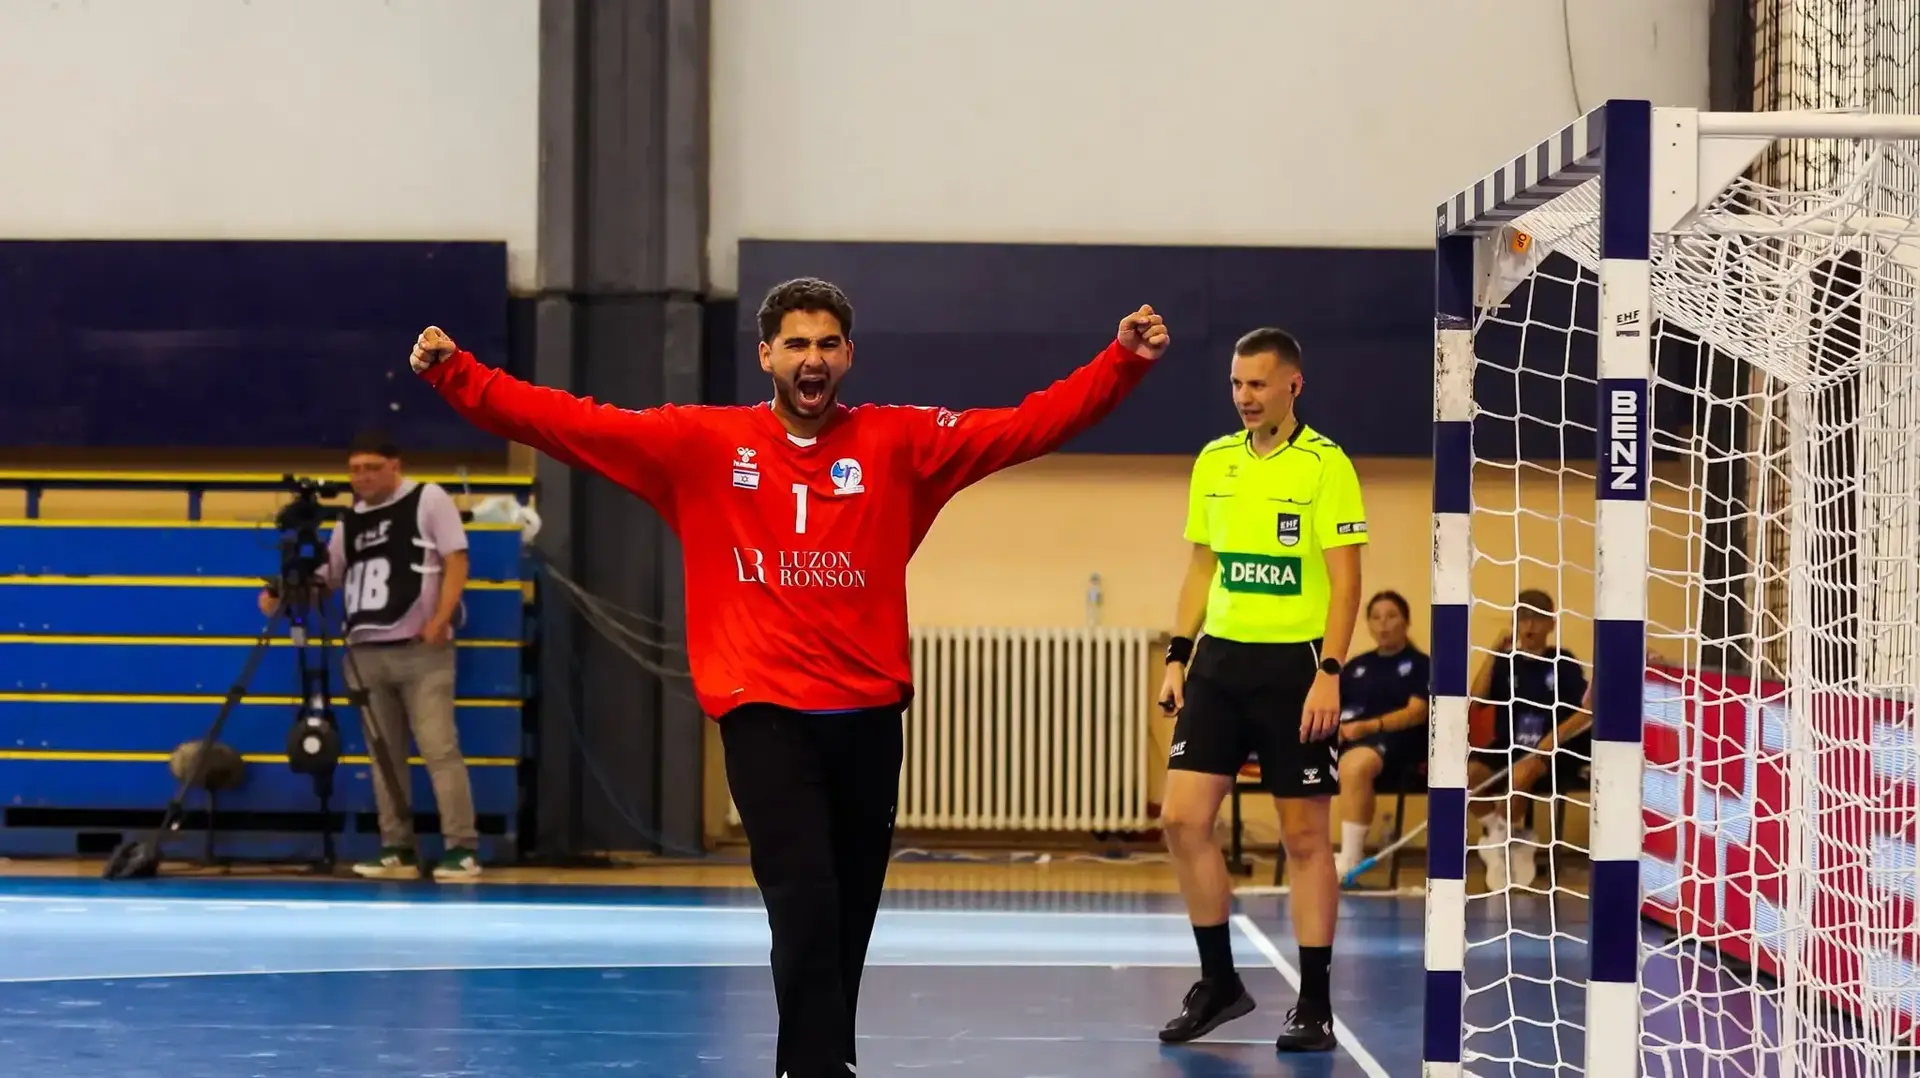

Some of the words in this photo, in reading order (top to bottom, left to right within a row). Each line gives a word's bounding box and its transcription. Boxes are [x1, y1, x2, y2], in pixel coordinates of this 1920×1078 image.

[1616, 310, 1640, 325] EHF
[1610, 390, 1638, 490] BENZ
[792, 483, 809, 534] 1
[1280, 519, 1298, 531] EHF
[779, 551, 852, 569] LUZON
[780, 569, 866, 588] RONSON
[1231, 561, 1297, 586] DEKRA
[345, 557, 391, 617] HB
